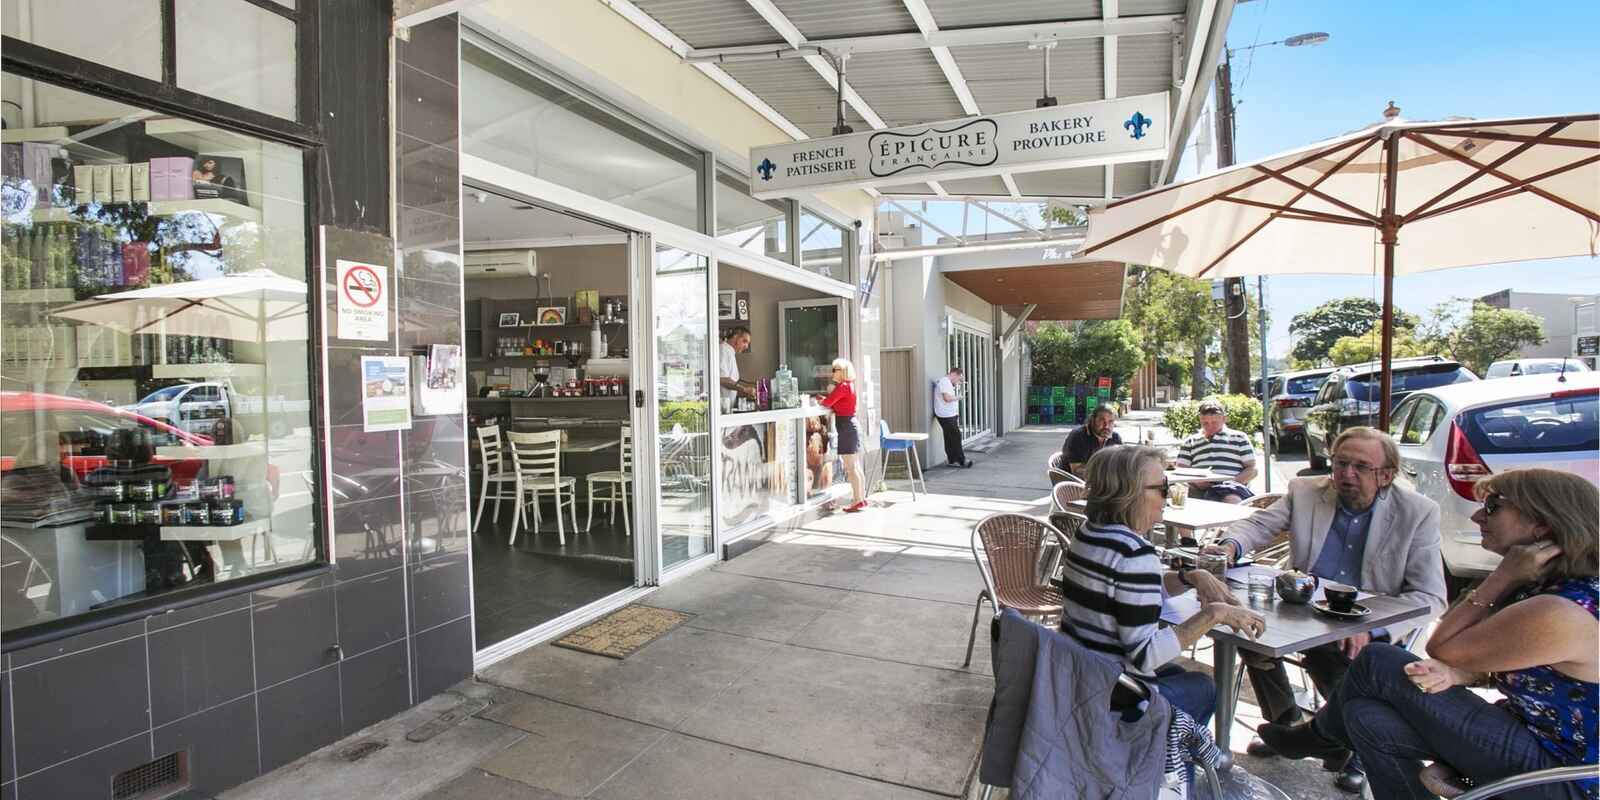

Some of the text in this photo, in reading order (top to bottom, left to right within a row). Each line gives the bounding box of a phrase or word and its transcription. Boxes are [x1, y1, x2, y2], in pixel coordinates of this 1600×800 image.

[1029, 116, 1093, 134] BAKERY
[880, 131, 986, 157] ÉPICURE
[1013, 130, 1106, 151] PROVIDORE
[793, 147, 844, 163] FRENCH
[880, 148, 986, 167] FRANÇAISE
[786, 159, 857, 177] PATISSERIE
[353, 309, 384, 317] SMOKING
